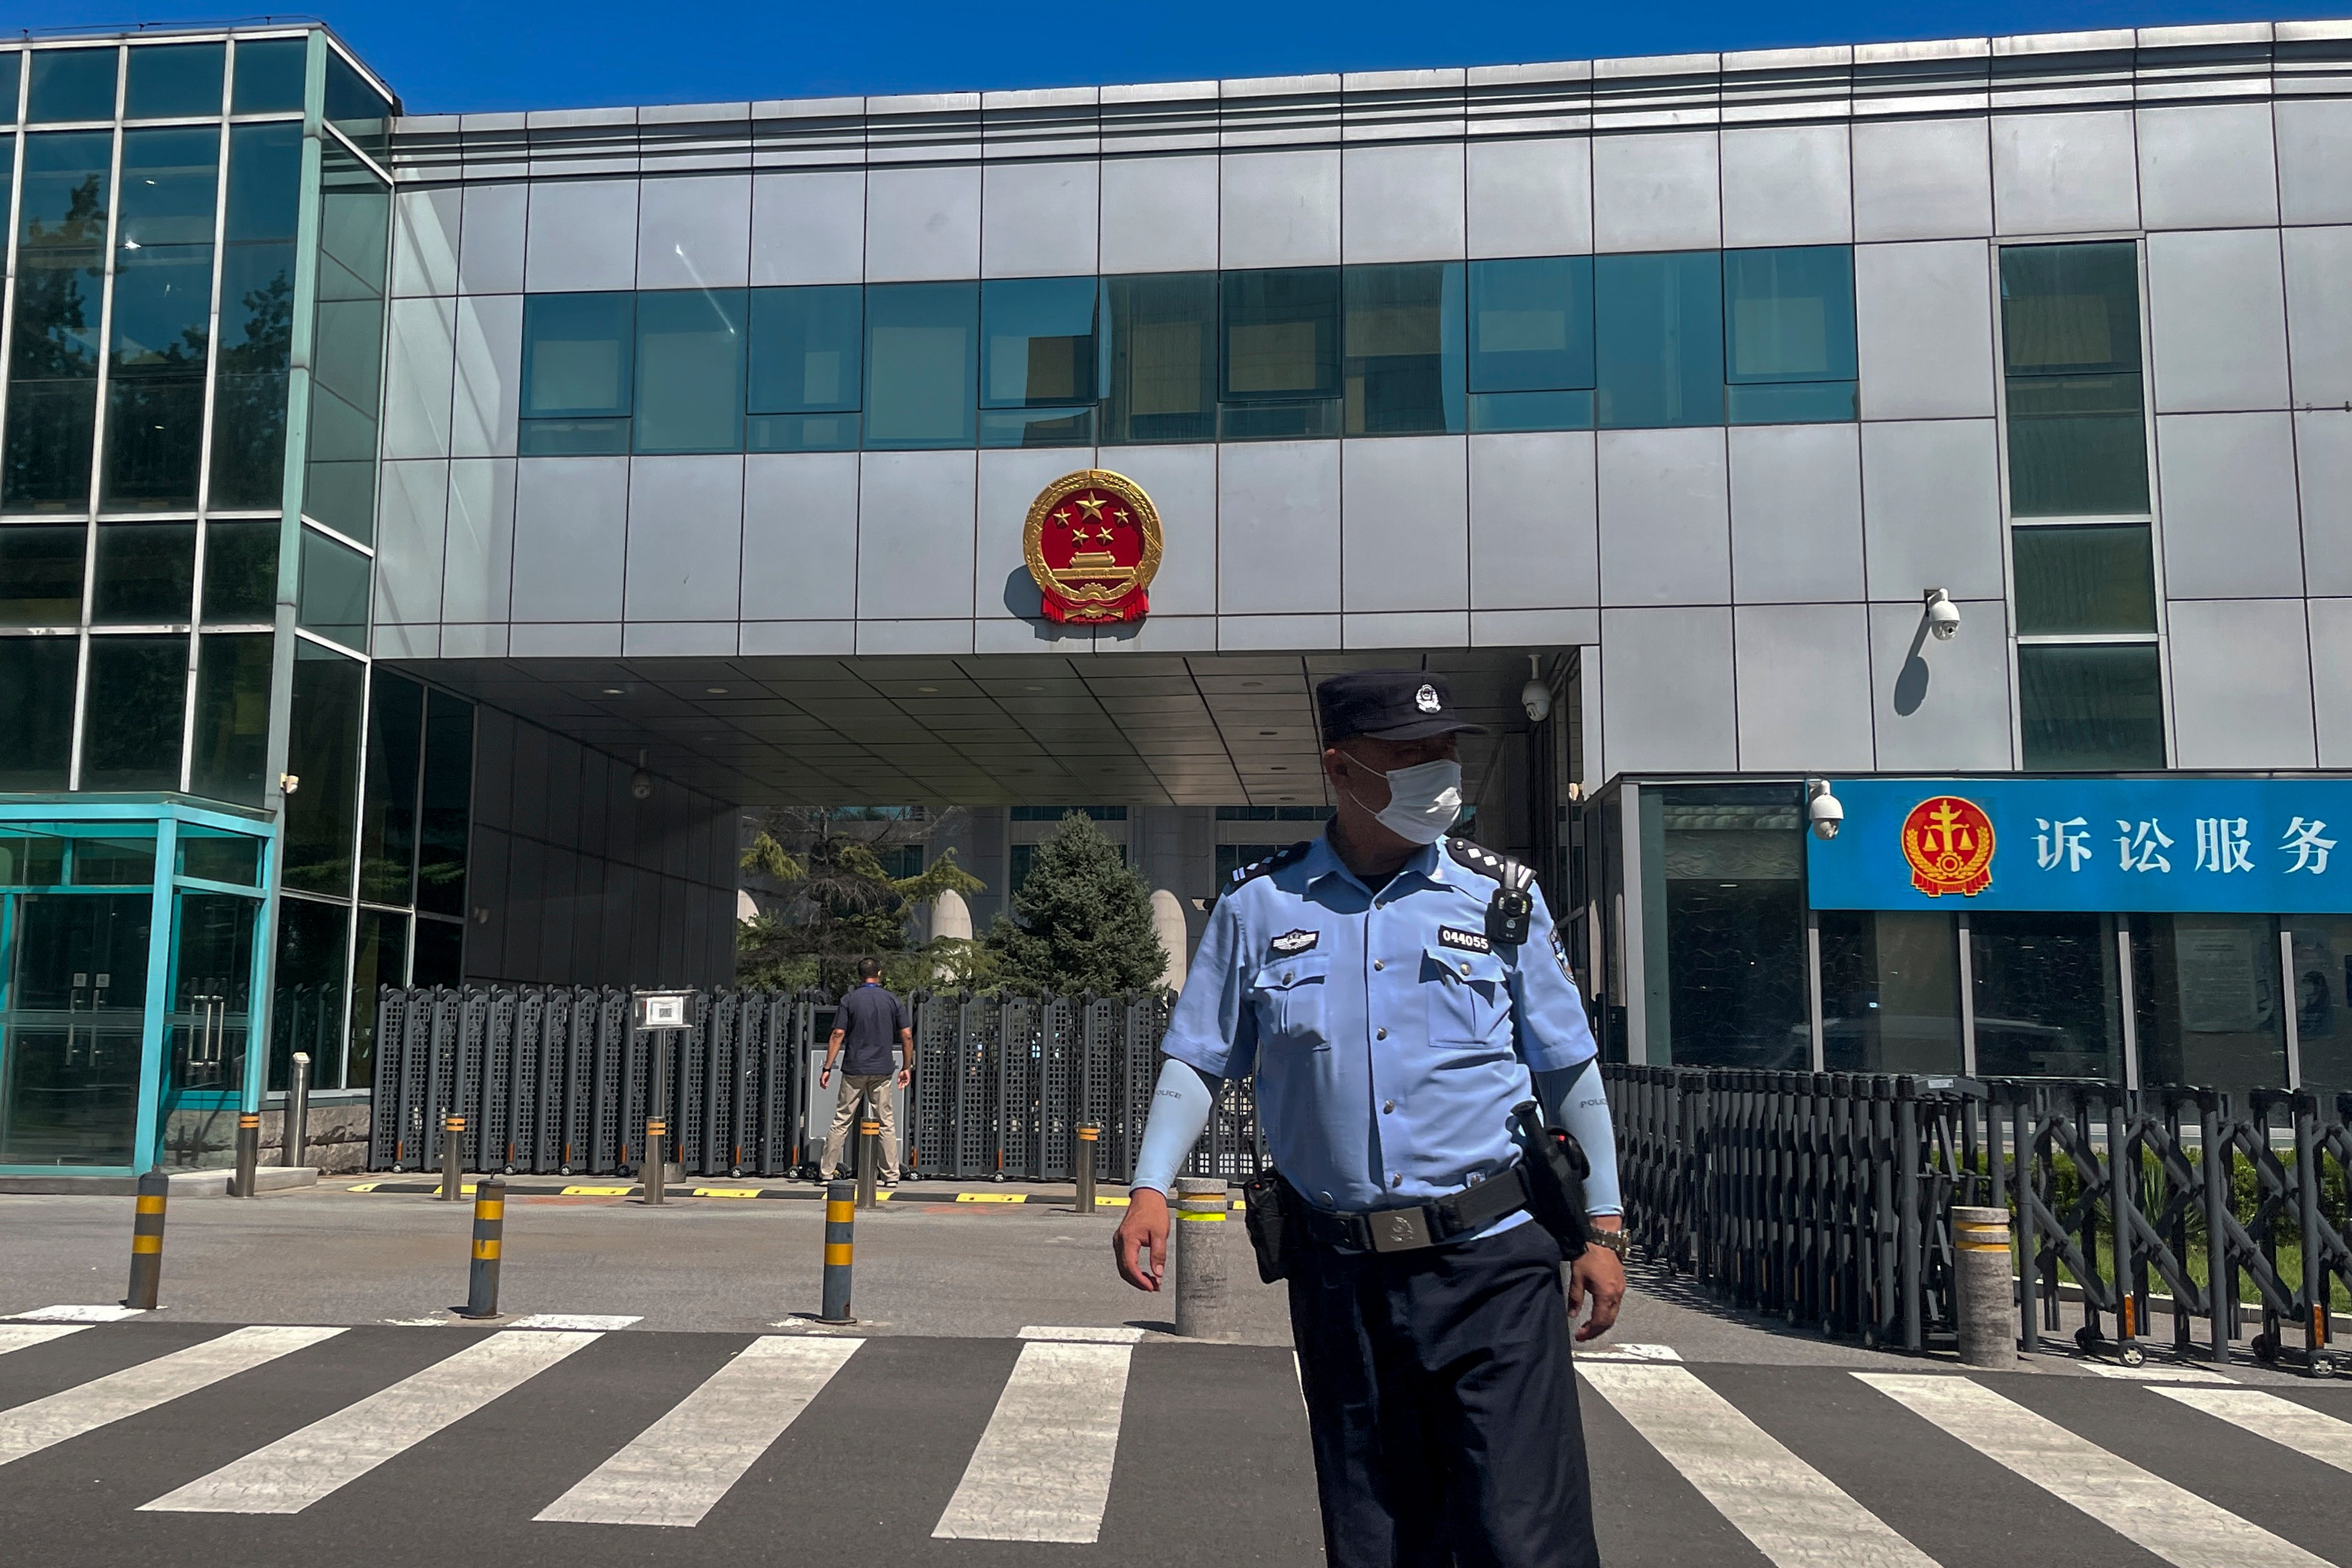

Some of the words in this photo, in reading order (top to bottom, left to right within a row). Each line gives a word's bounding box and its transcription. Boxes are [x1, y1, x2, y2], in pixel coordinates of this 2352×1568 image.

[2031, 817, 2337, 874] 诉讼服务
[1443, 930, 1489, 949] 044055
